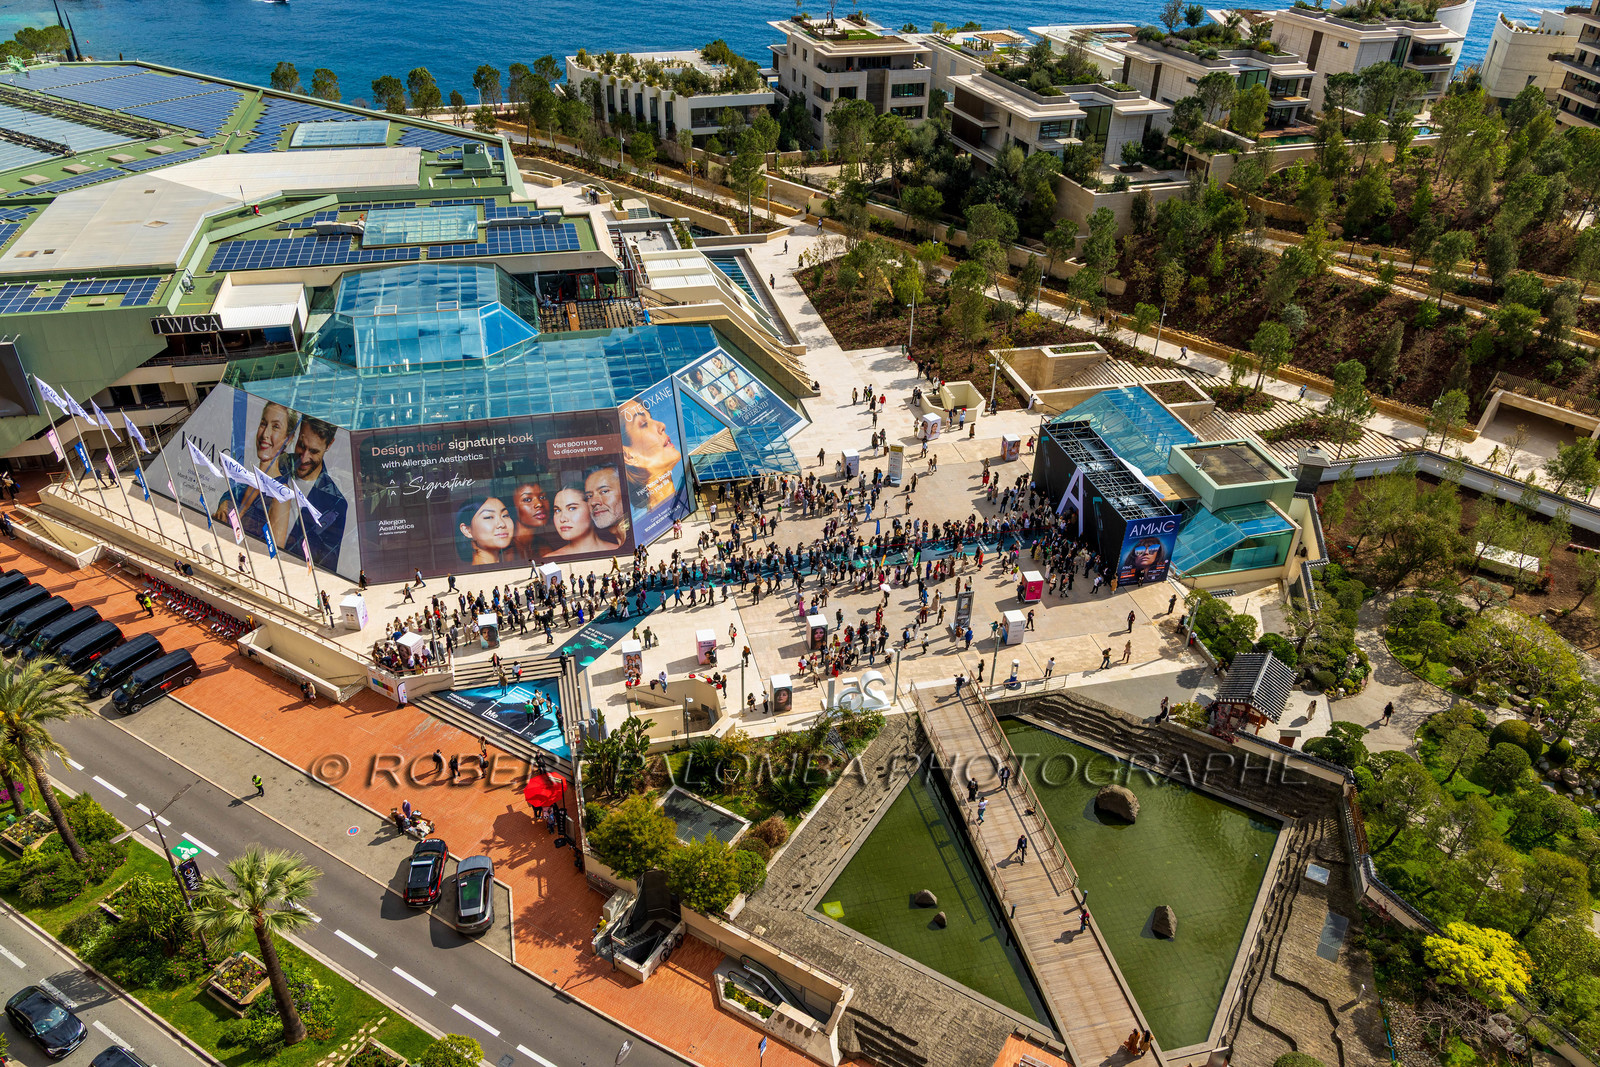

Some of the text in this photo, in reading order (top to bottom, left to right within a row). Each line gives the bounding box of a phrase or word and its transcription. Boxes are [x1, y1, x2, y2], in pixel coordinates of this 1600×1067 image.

[151, 315, 222, 334] TWIGA
[631, 386, 673, 416] TEOXANE
[371, 432, 534, 457] Design their signature look
[561, 447, 587, 455] discover
[567, 440, 589, 448] BOOTH
[381, 453, 484, 469] with Allergan Aesthetics
[402, 472, 476, 499] Signature
[378, 518, 406, 526] Allergan
[378, 524, 415, 532] Aesthetics
[1129, 520, 1176, 537] AMWC
